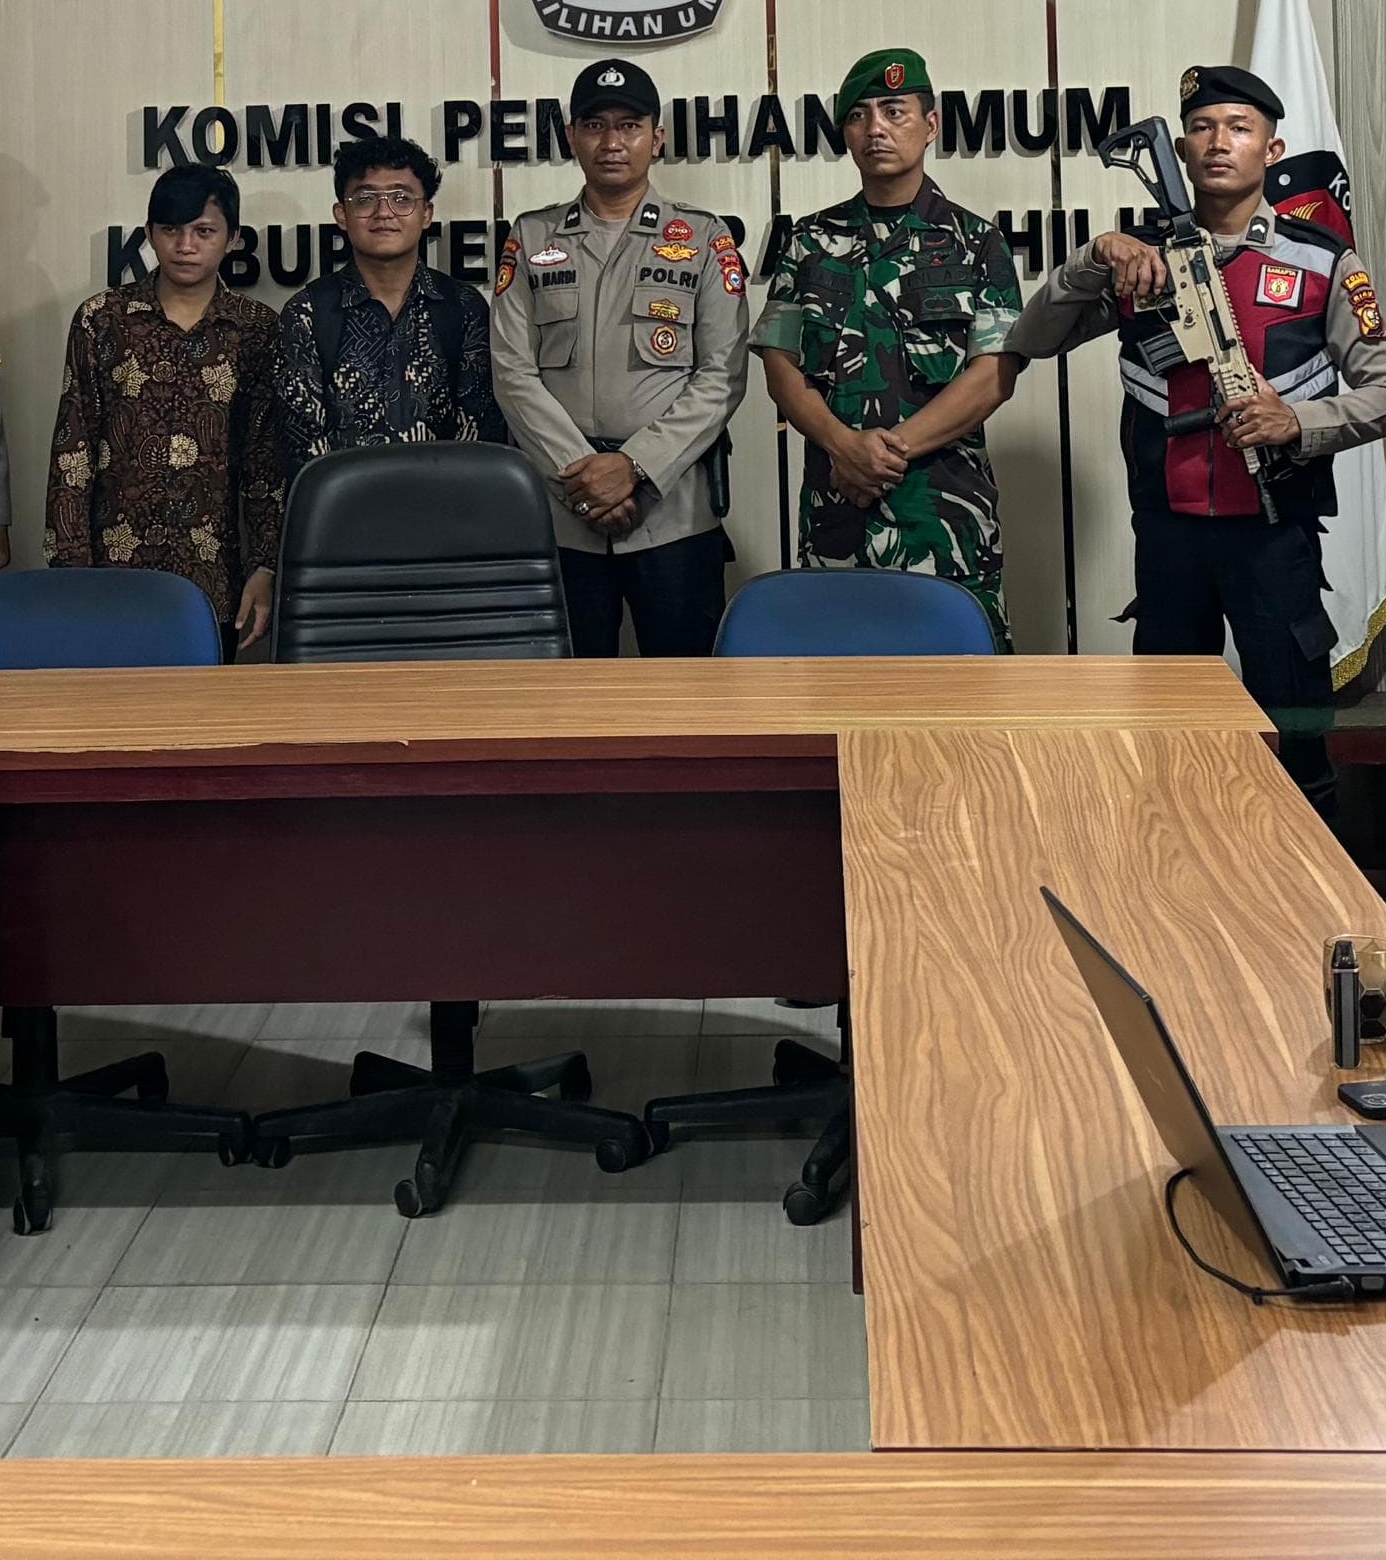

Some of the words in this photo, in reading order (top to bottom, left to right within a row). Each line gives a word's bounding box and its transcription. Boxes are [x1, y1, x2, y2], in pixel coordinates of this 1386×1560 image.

[143, 102, 403, 168] KOMISI
[444, 93, 849, 162] PEMIHAN
[941, 86, 1131, 154] MUM
[640, 266, 699, 290] POLRI
